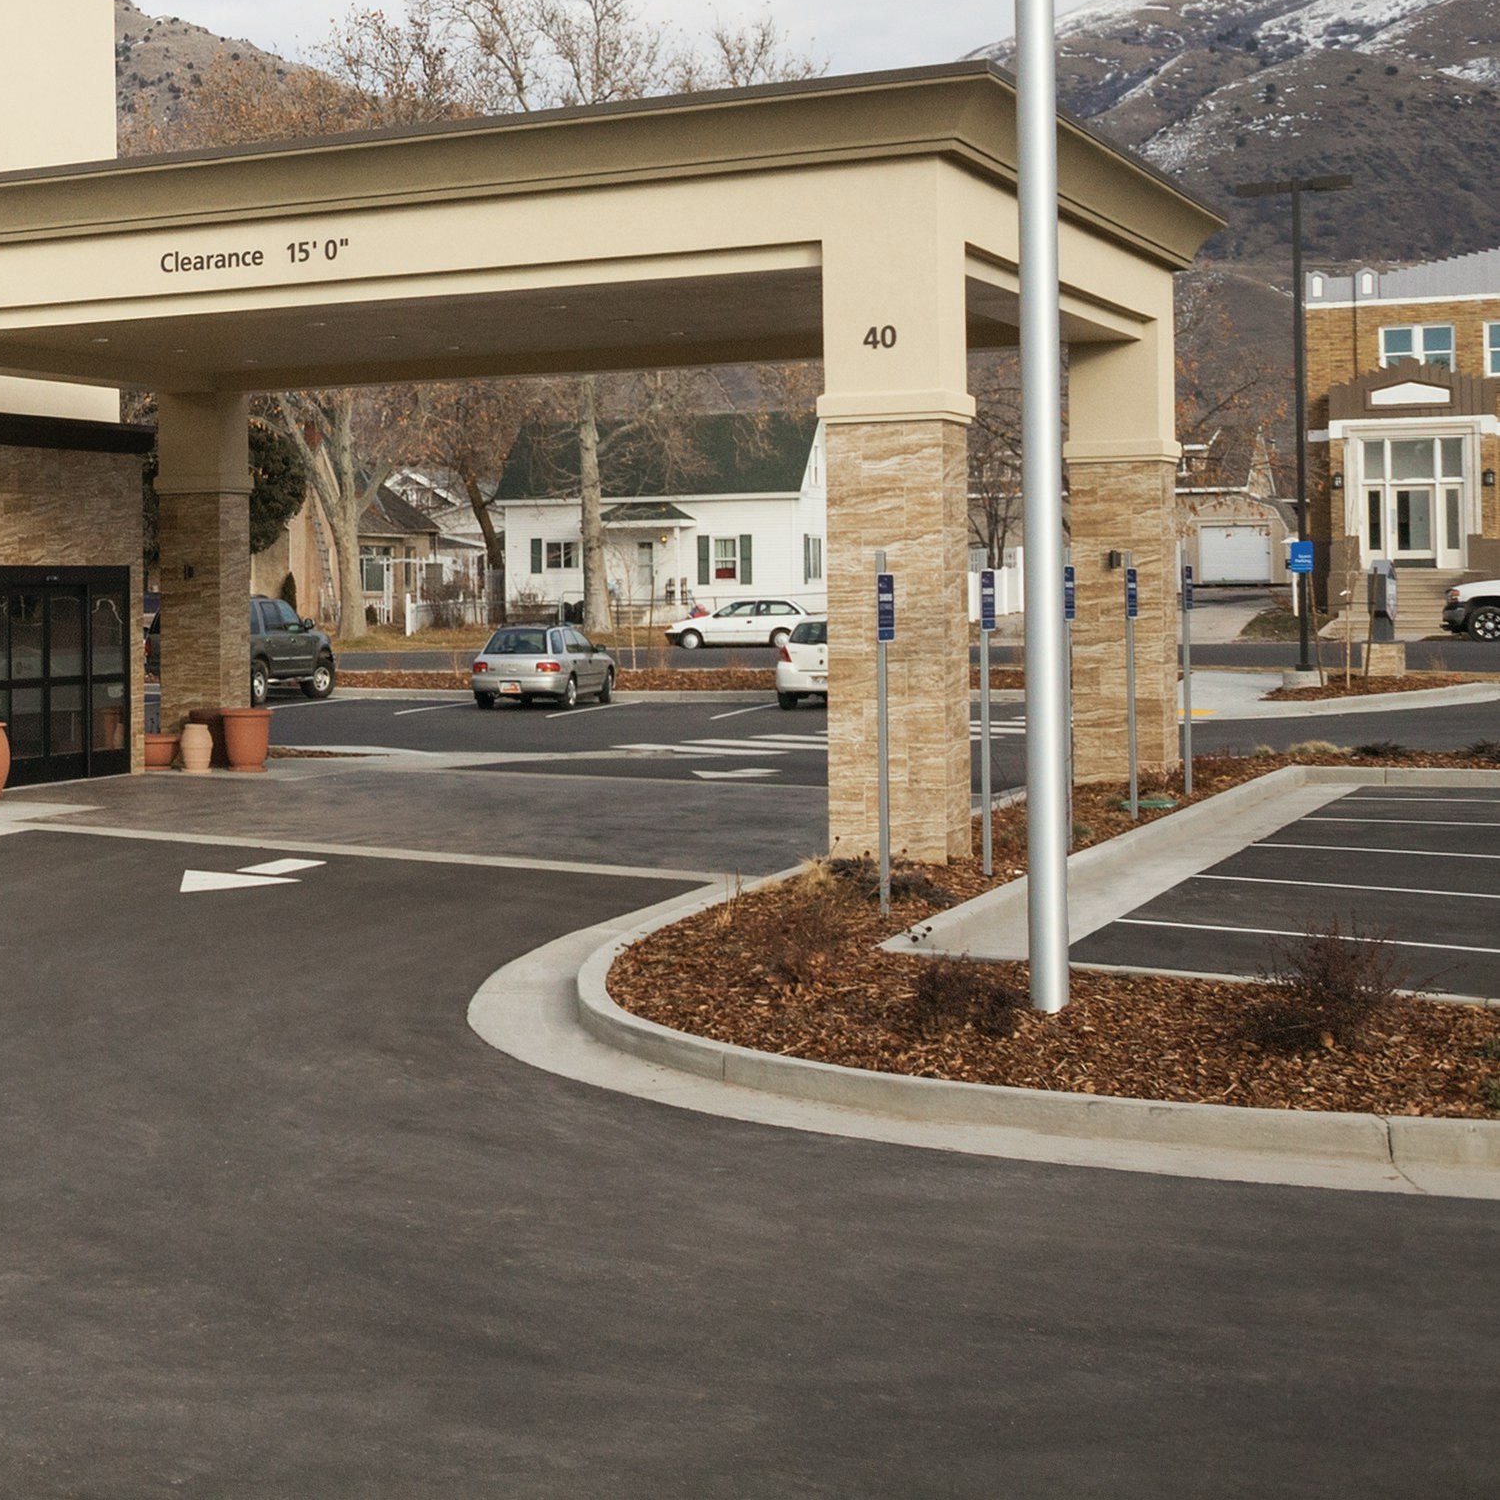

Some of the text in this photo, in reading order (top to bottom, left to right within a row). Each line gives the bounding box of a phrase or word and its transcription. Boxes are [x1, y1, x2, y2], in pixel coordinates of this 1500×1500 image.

[160, 238, 349, 273] Clearance 15' 0"
[863, 325, 897, 349] 40
